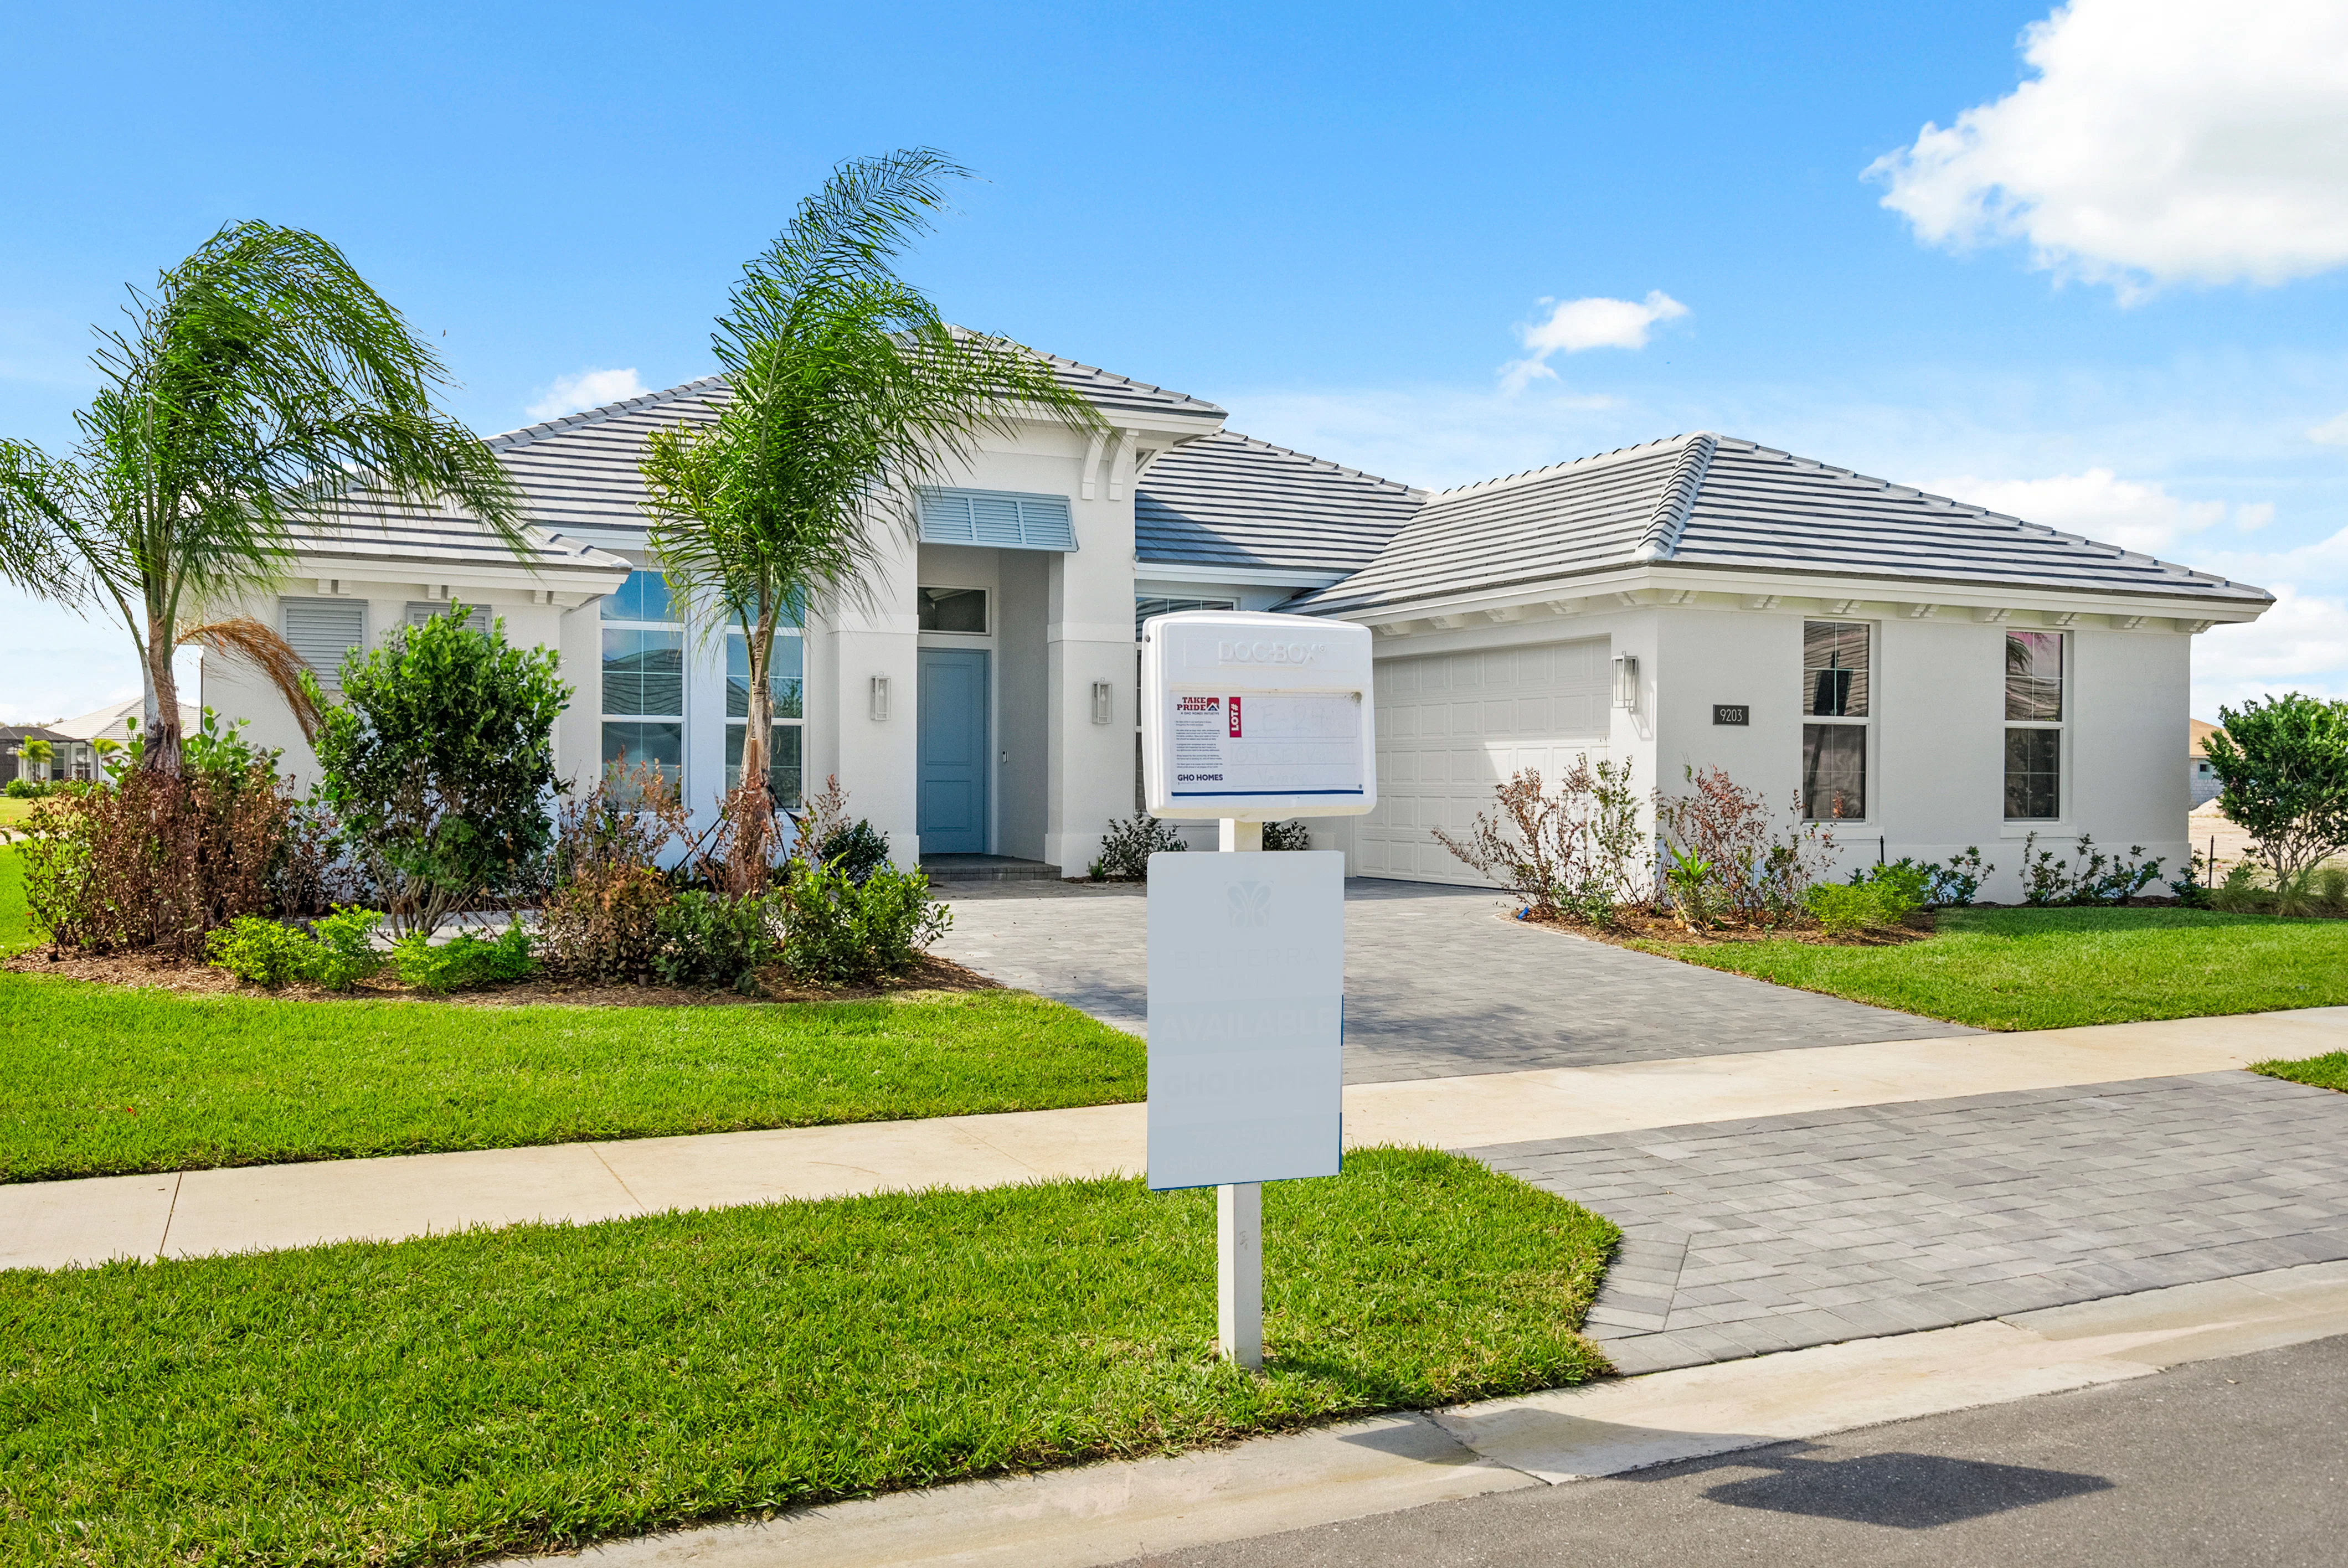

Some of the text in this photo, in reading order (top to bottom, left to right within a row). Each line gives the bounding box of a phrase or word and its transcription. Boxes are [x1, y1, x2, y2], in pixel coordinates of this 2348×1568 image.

[1230, 703, 1239, 731] LOT#
[1719, 709, 1743, 721] 9203
[1157, 1005, 1334, 1043] AVAILABLE
